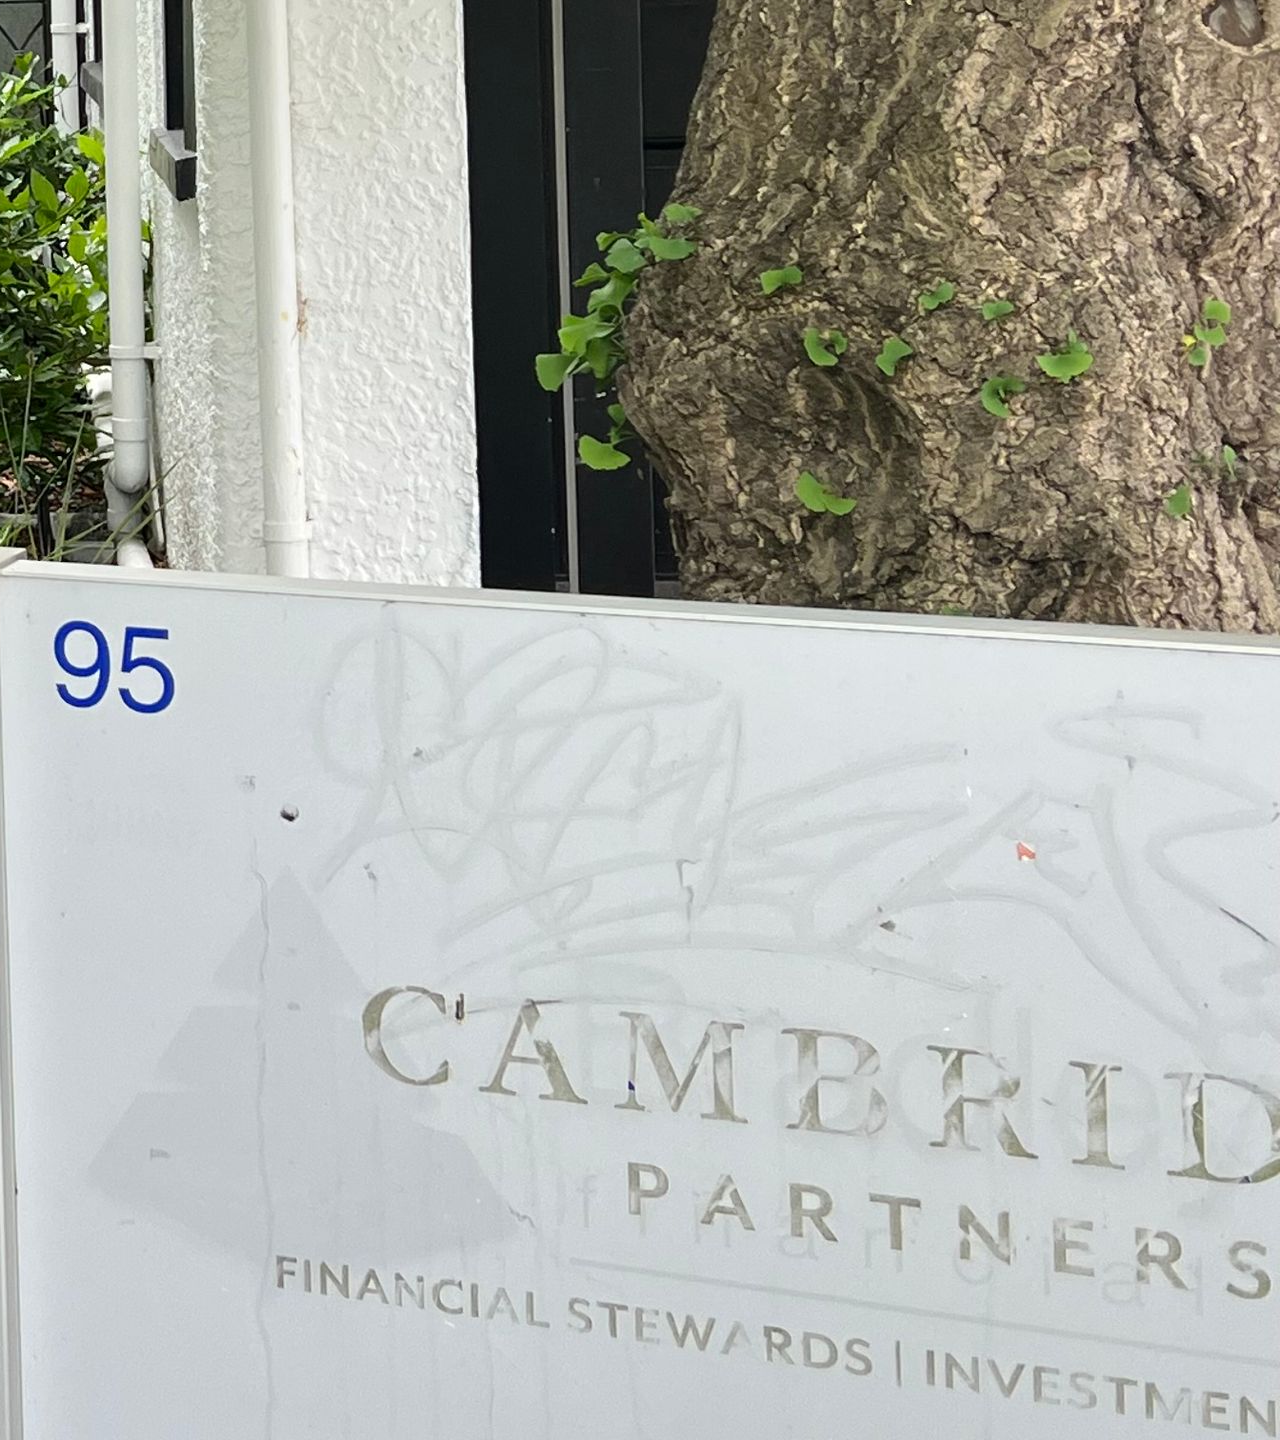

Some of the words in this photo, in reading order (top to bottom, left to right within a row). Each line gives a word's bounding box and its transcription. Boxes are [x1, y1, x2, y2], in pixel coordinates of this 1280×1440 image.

[54, 620, 175, 714] 95
[362, 985, 1280, 1185] CAMBRID
[627, 1161, 1272, 1300] PARTNERS
[275, 1254, 550, 1329] FINANCIAL
[567, 1296, 873, 1376] STEWARDS
[926, 1348, 1278, 1437] INVESTMEN
